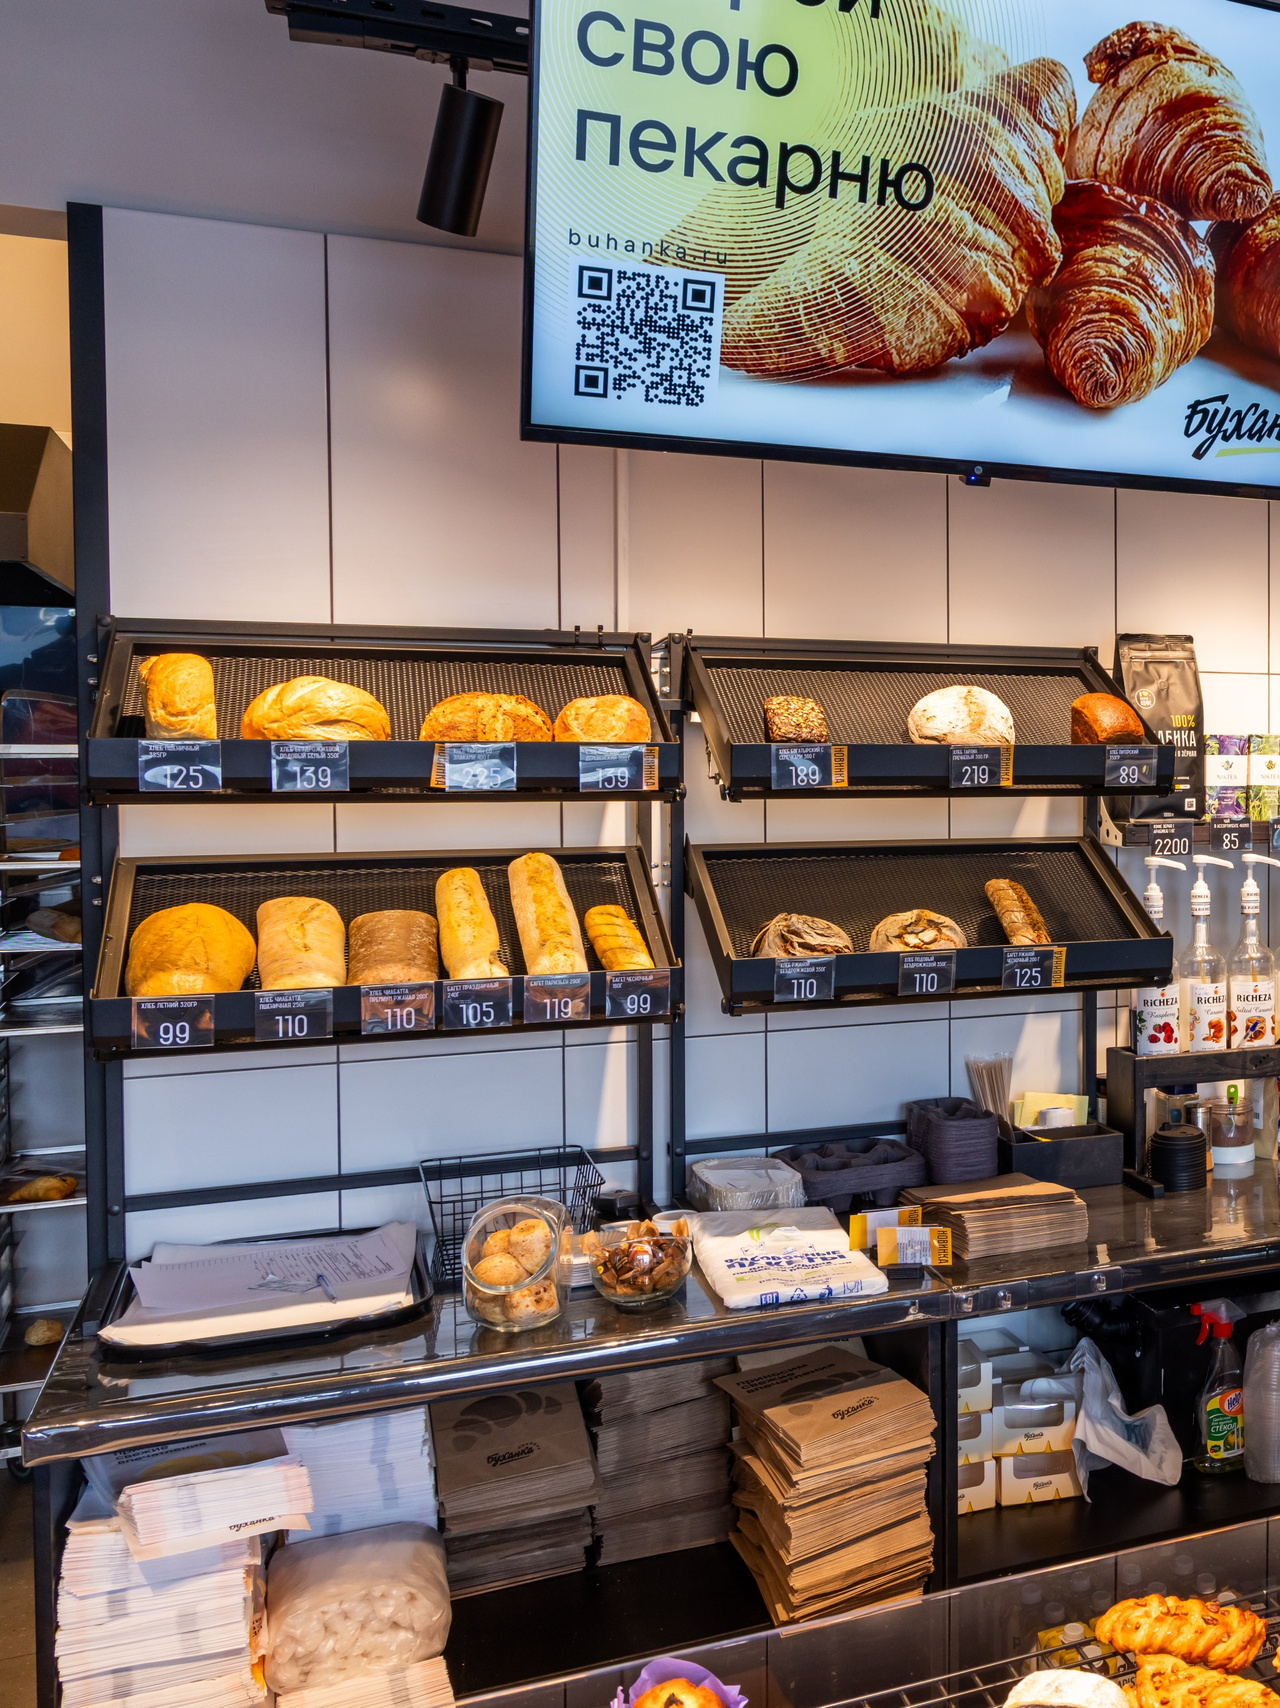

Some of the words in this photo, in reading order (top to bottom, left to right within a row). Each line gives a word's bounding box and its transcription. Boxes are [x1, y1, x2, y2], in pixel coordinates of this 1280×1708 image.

[577, 10, 799, 97] свою
[575, 108, 935, 212] пекарню
[568, 228, 729, 265] buhanka.ru
[1170, 714, 1196, 728] 100%
[1153, 730, 1197, 747] АБИКА
[644, 748, 656, 787] НОВИНКА
[789, 766, 820, 786] 189
[833, 747, 845, 784] НОВИНКА
[961, 765, 989, 785] 219
[1119, 766, 1138, 783] 89
[163, 766, 203, 789] 125
[293, 766, 332, 789] 139
[462, 768, 501, 789] 225
[597, 768, 629, 789] 139
[1154, 838, 1189, 855] 2200
[1223, 833, 1239, 849] 85
[1014, 967, 1041, 987] 125
[1053, 949, 1064, 985] НОВИНКА
[791, 978, 817, 999] 110
[914, 973, 938, 993] 110
[459, 1002, 494, 1025] 105
[544, 998, 572, 1020] 119
[626, 994, 651, 1015] 99
[275, 1015, 308, 1038] 110
[384, 1007, 416, 1030] 110
[159, 1022, 190, 1045] 99
[937, 1229, 949, 1264] НОВИНКА
[1227, 1391, 1242, 1410] Help
